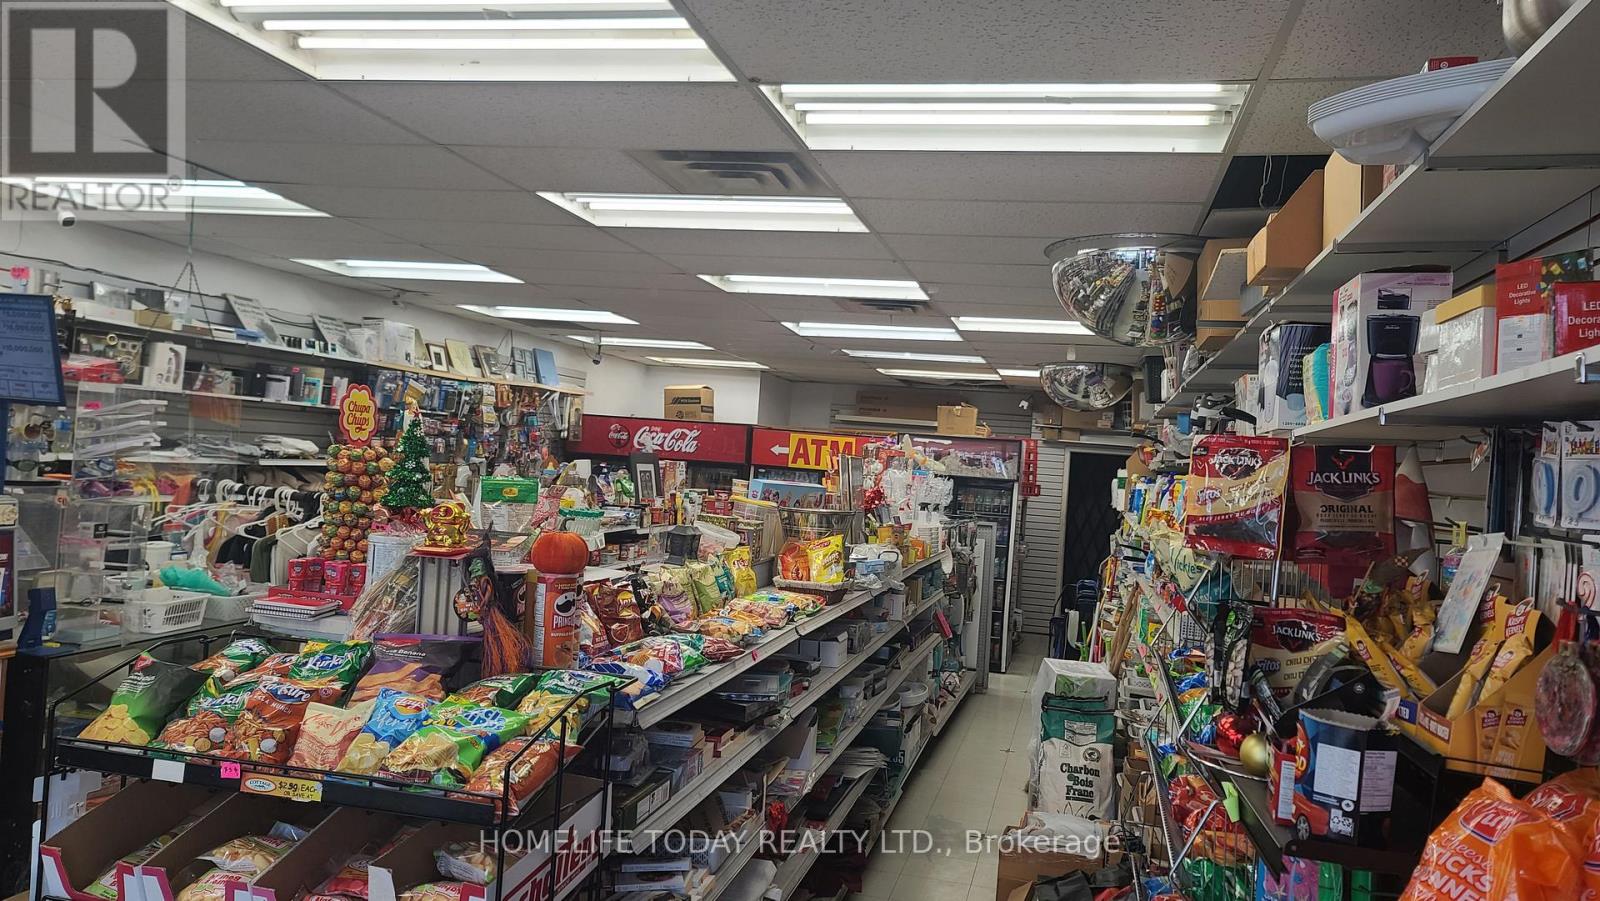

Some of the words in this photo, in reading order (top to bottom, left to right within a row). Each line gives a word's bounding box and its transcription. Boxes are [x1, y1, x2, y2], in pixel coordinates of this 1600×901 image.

[1509, 290, 1537, 298] Decorative
[348, 401, 372, 416] Chupa
[347, 413, 370, 434] Chups
[633, 425, 701, 453] Coca-Cola
[1307, 471, 1341, 484] JACK
[1320, 504, 1374, 513] ORIGINAL
[1271, 625, 1294, 637] JACK
[1060, 762, 1100, 777] Charbon
[1072, 776, 1093, 788] Bois
[1066, 785, 1094, 798] Franc
[1441, 832, 1493, 869] Cheese
